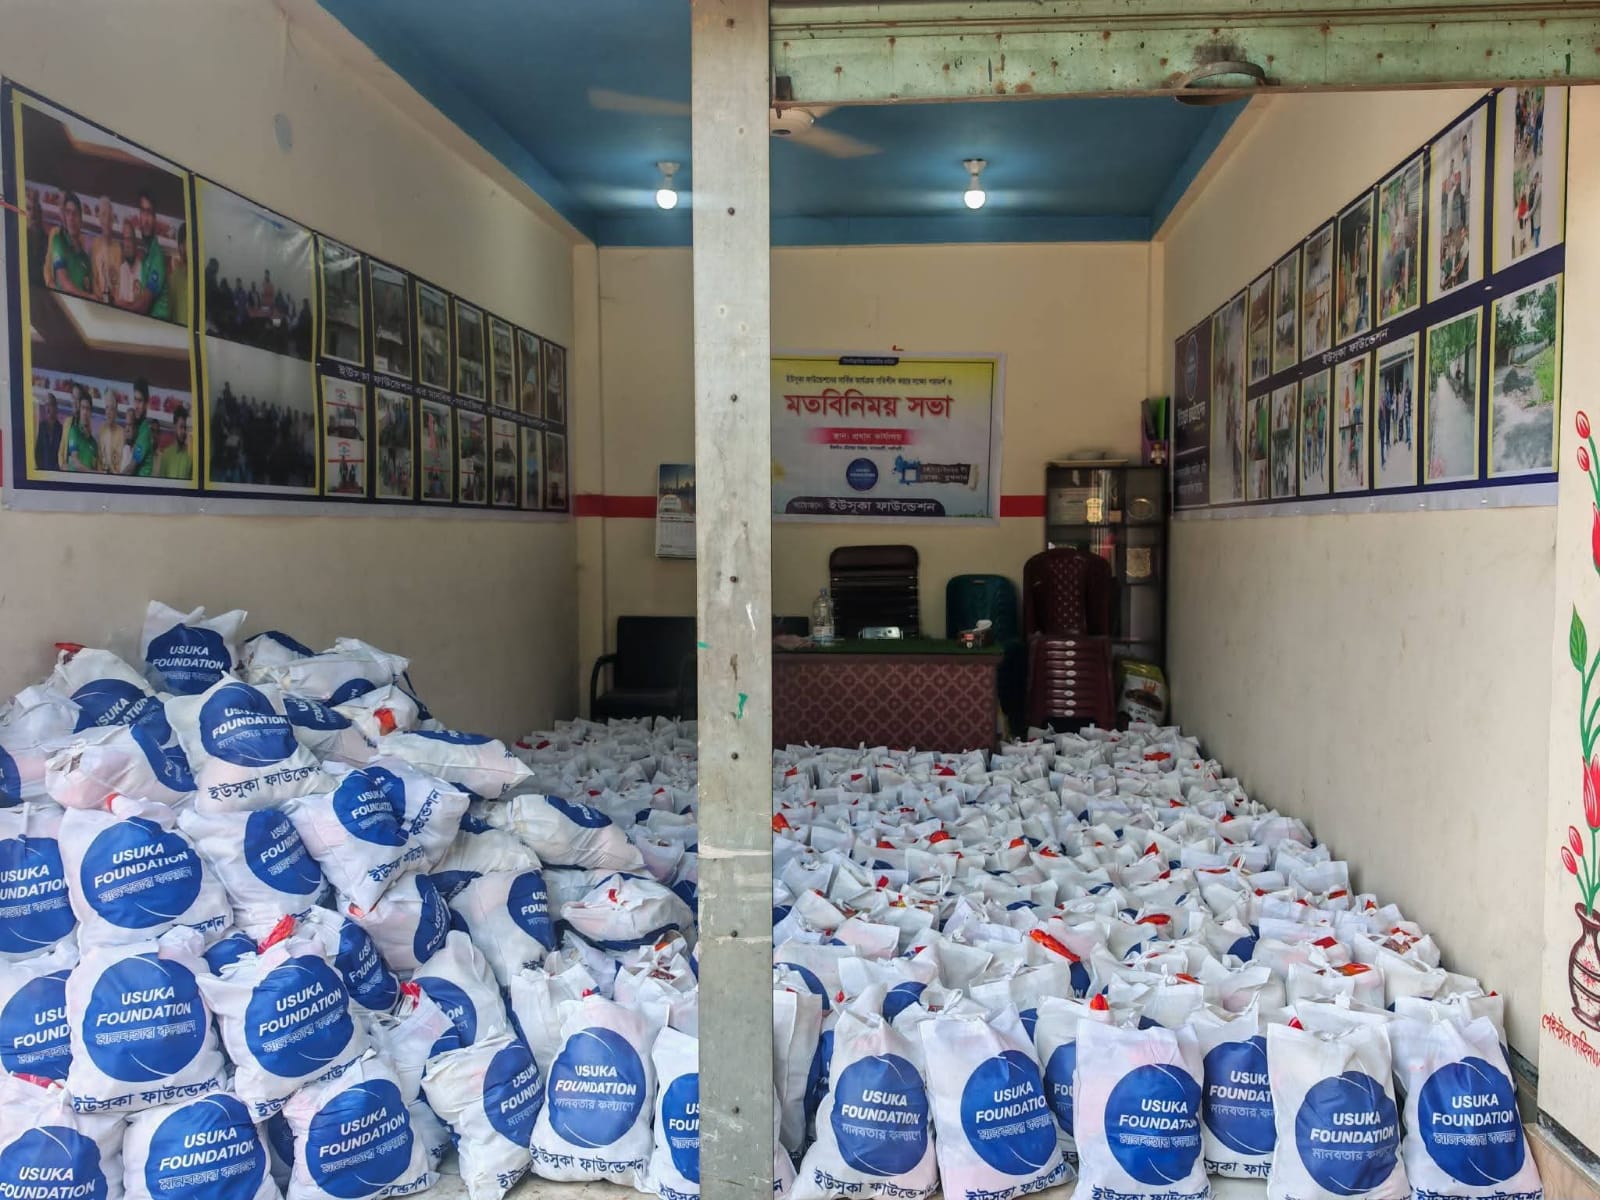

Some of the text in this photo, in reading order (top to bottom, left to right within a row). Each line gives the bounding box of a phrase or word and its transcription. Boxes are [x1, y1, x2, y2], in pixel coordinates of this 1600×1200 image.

[784, 388, 955, 418] মতবিনিময় সভা
[875, 500, 936, 512] ফাউন্ডেশন
[169, 645, 209, 656] USUKA
[152, 658, 224, 670] FOUNDATION
[212, 716, 287, 739] FOUNDATION
[208, 777, 260, 801] ইউসুকা
[112, 842, 165, 864] USUKA
[94, 850, 189, 889] FOUNDATION
[122, 986, 175, 1006] USUKA
[276, 982, 324, 1012] USUKA
[35, 1006, 67, 1026] USU
[96, 1002, 191, 1027] FOUNDATION
[259, 988, 342, 1037] FOUNDATION
[14, 1023, 72, 1049] FOUND
[574, 1065, 618, 1078] USUKA
[555, 1079, 637, 1096] FOUNDATION
[863, 1089, 908, 1107] USUKA
[994, 1081, 1034, 1103] USUKA
[1141, 1099, 1188, 1114] USUKA
[1452, 1093, 1499, 1110] USUKA
[341, 1107, 387, 1136] USUKA
[841, 1104, 921, 1125] FOUNDATION
[1332, 1111, 1382, 1126] USUKA
[184, 1127, 237, 1148] USUKA
[320, 1112, 405, 1158] FOUNDATION
[1310, 1125, 1395, 1145] FOUNDATION
[160, 1139, 255, 1171] FOUNDATION
[529, 1143, 645, 1175] ইউসুকা ফাউন্ডেশন
[19, 1166, 74, 1181] USUKA
[0, 1179, 95, 1199] FOUNDATION
